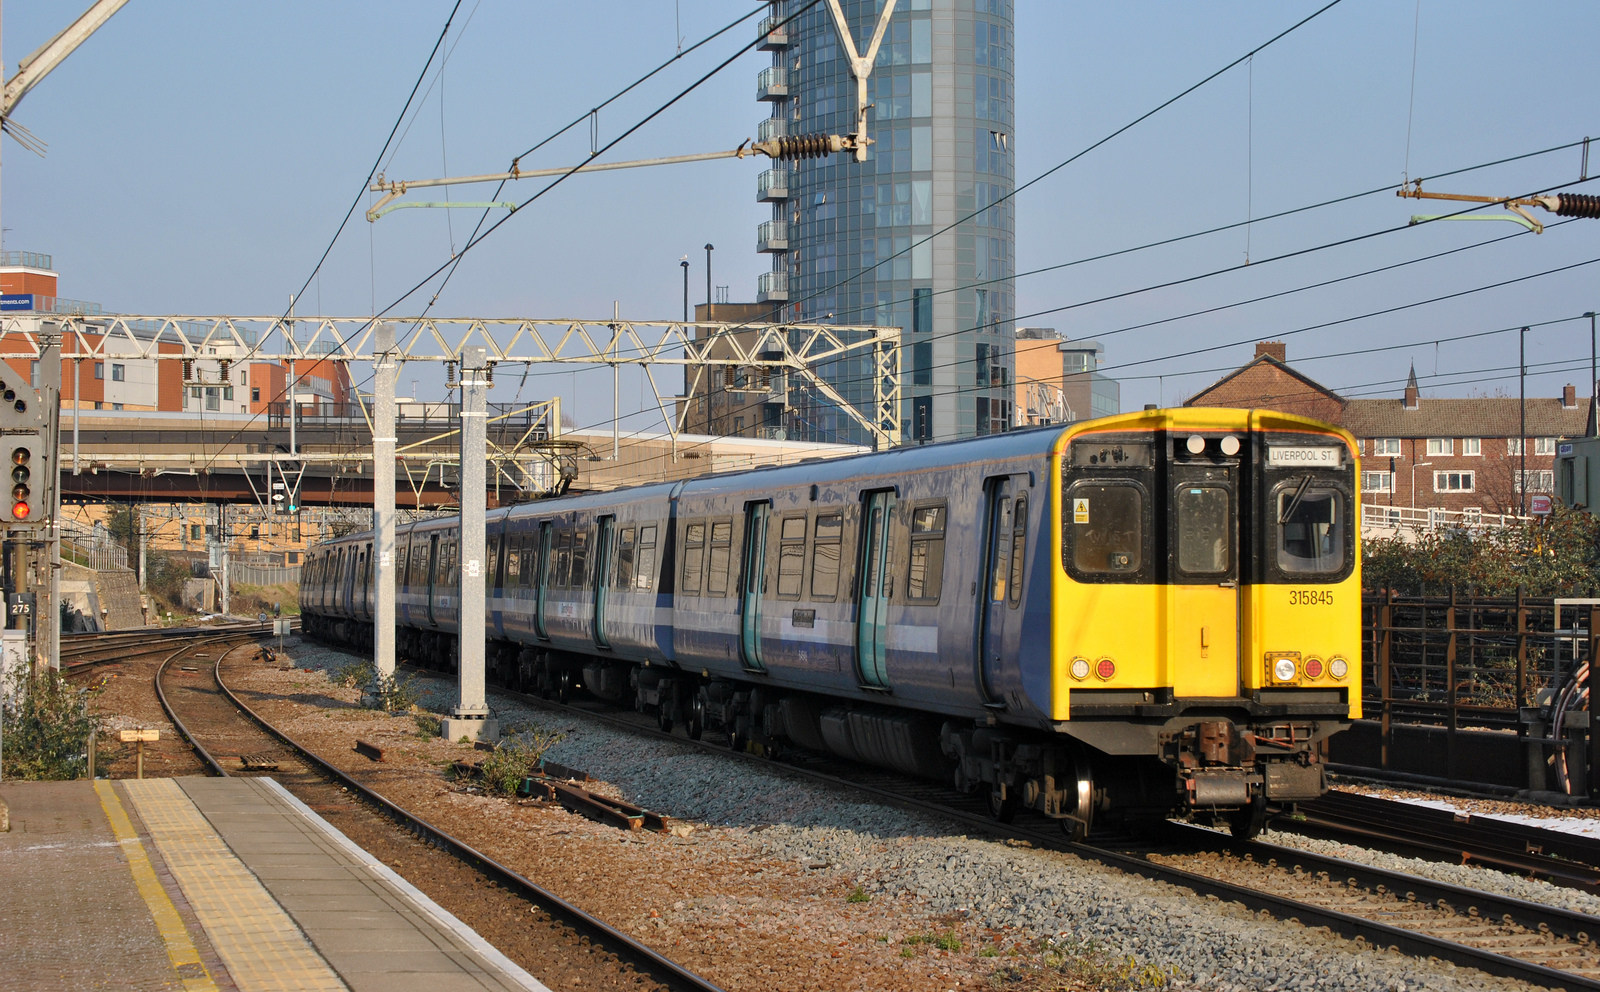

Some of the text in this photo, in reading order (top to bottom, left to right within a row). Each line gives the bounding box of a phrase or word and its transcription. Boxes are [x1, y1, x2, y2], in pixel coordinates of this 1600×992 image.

[1272, 450, 1334, 461] LIVERPOOL ST.
[17, 595, 23, 603] L
[1289, 590, 1334, 605] 315845
[12, 604, 30, 613] 275
